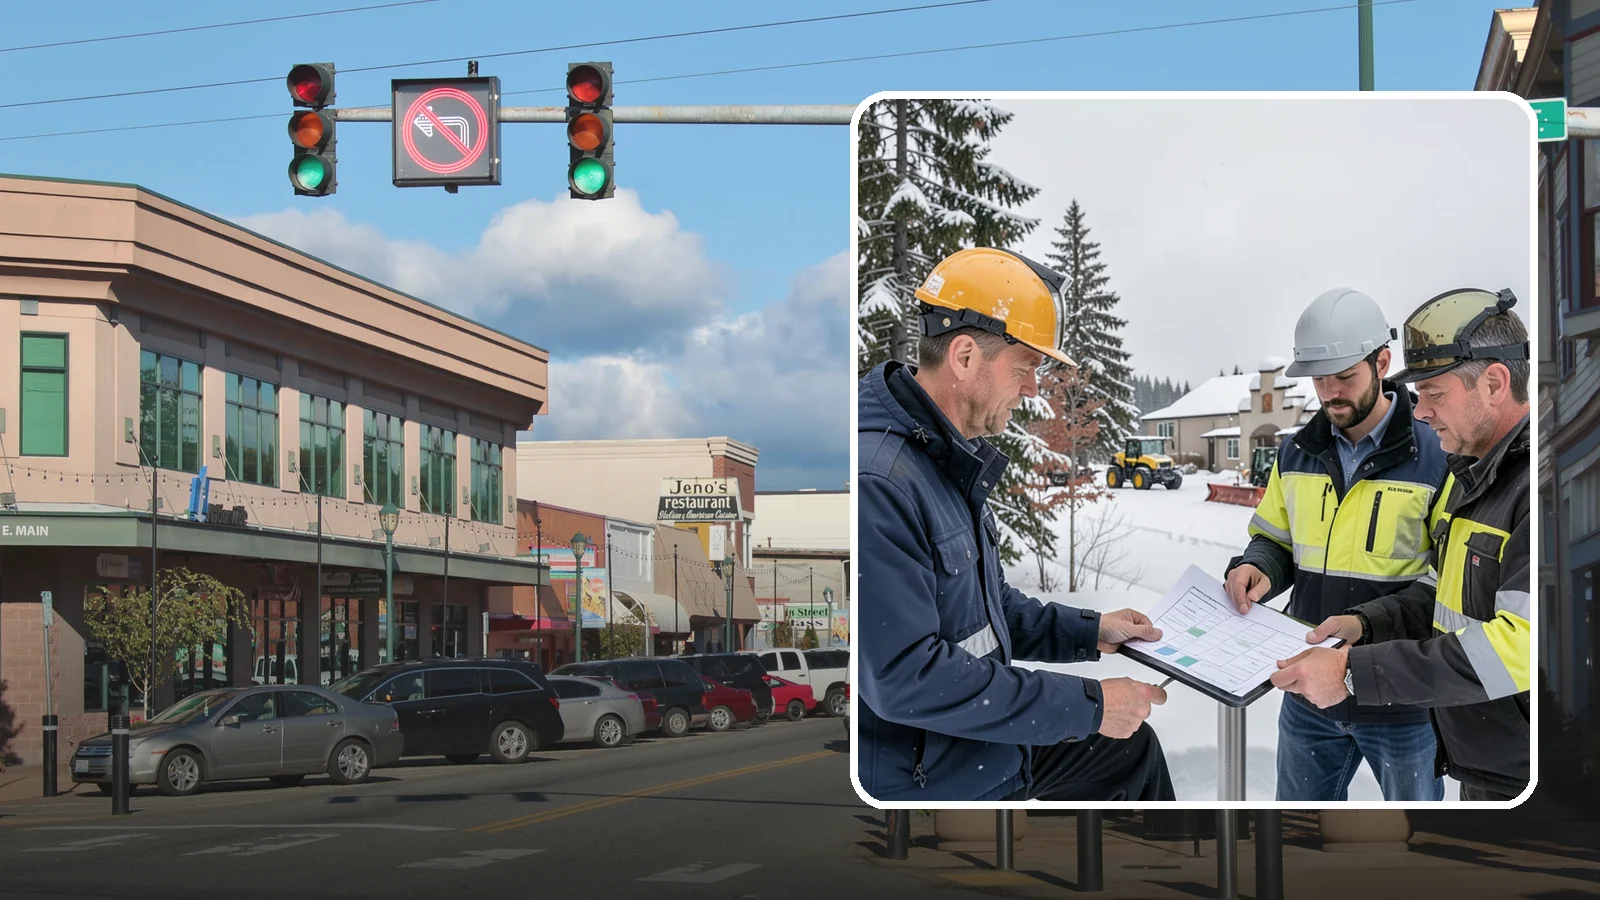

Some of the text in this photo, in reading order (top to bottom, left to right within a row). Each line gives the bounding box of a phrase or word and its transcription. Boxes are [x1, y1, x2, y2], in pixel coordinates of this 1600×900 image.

[669, 480, 728, 494] Jeno's
[665, 496, 731, 509] restaurant
[658, 510, 681, 519] Italian
[686, 510, 714, 519] American
[715, 510, 737, 519] Cuisine
[2, 525, 49, 537] E. MAIN
[786, 607, 829, 617] in Street
[791, 619, 824, 627] lass
